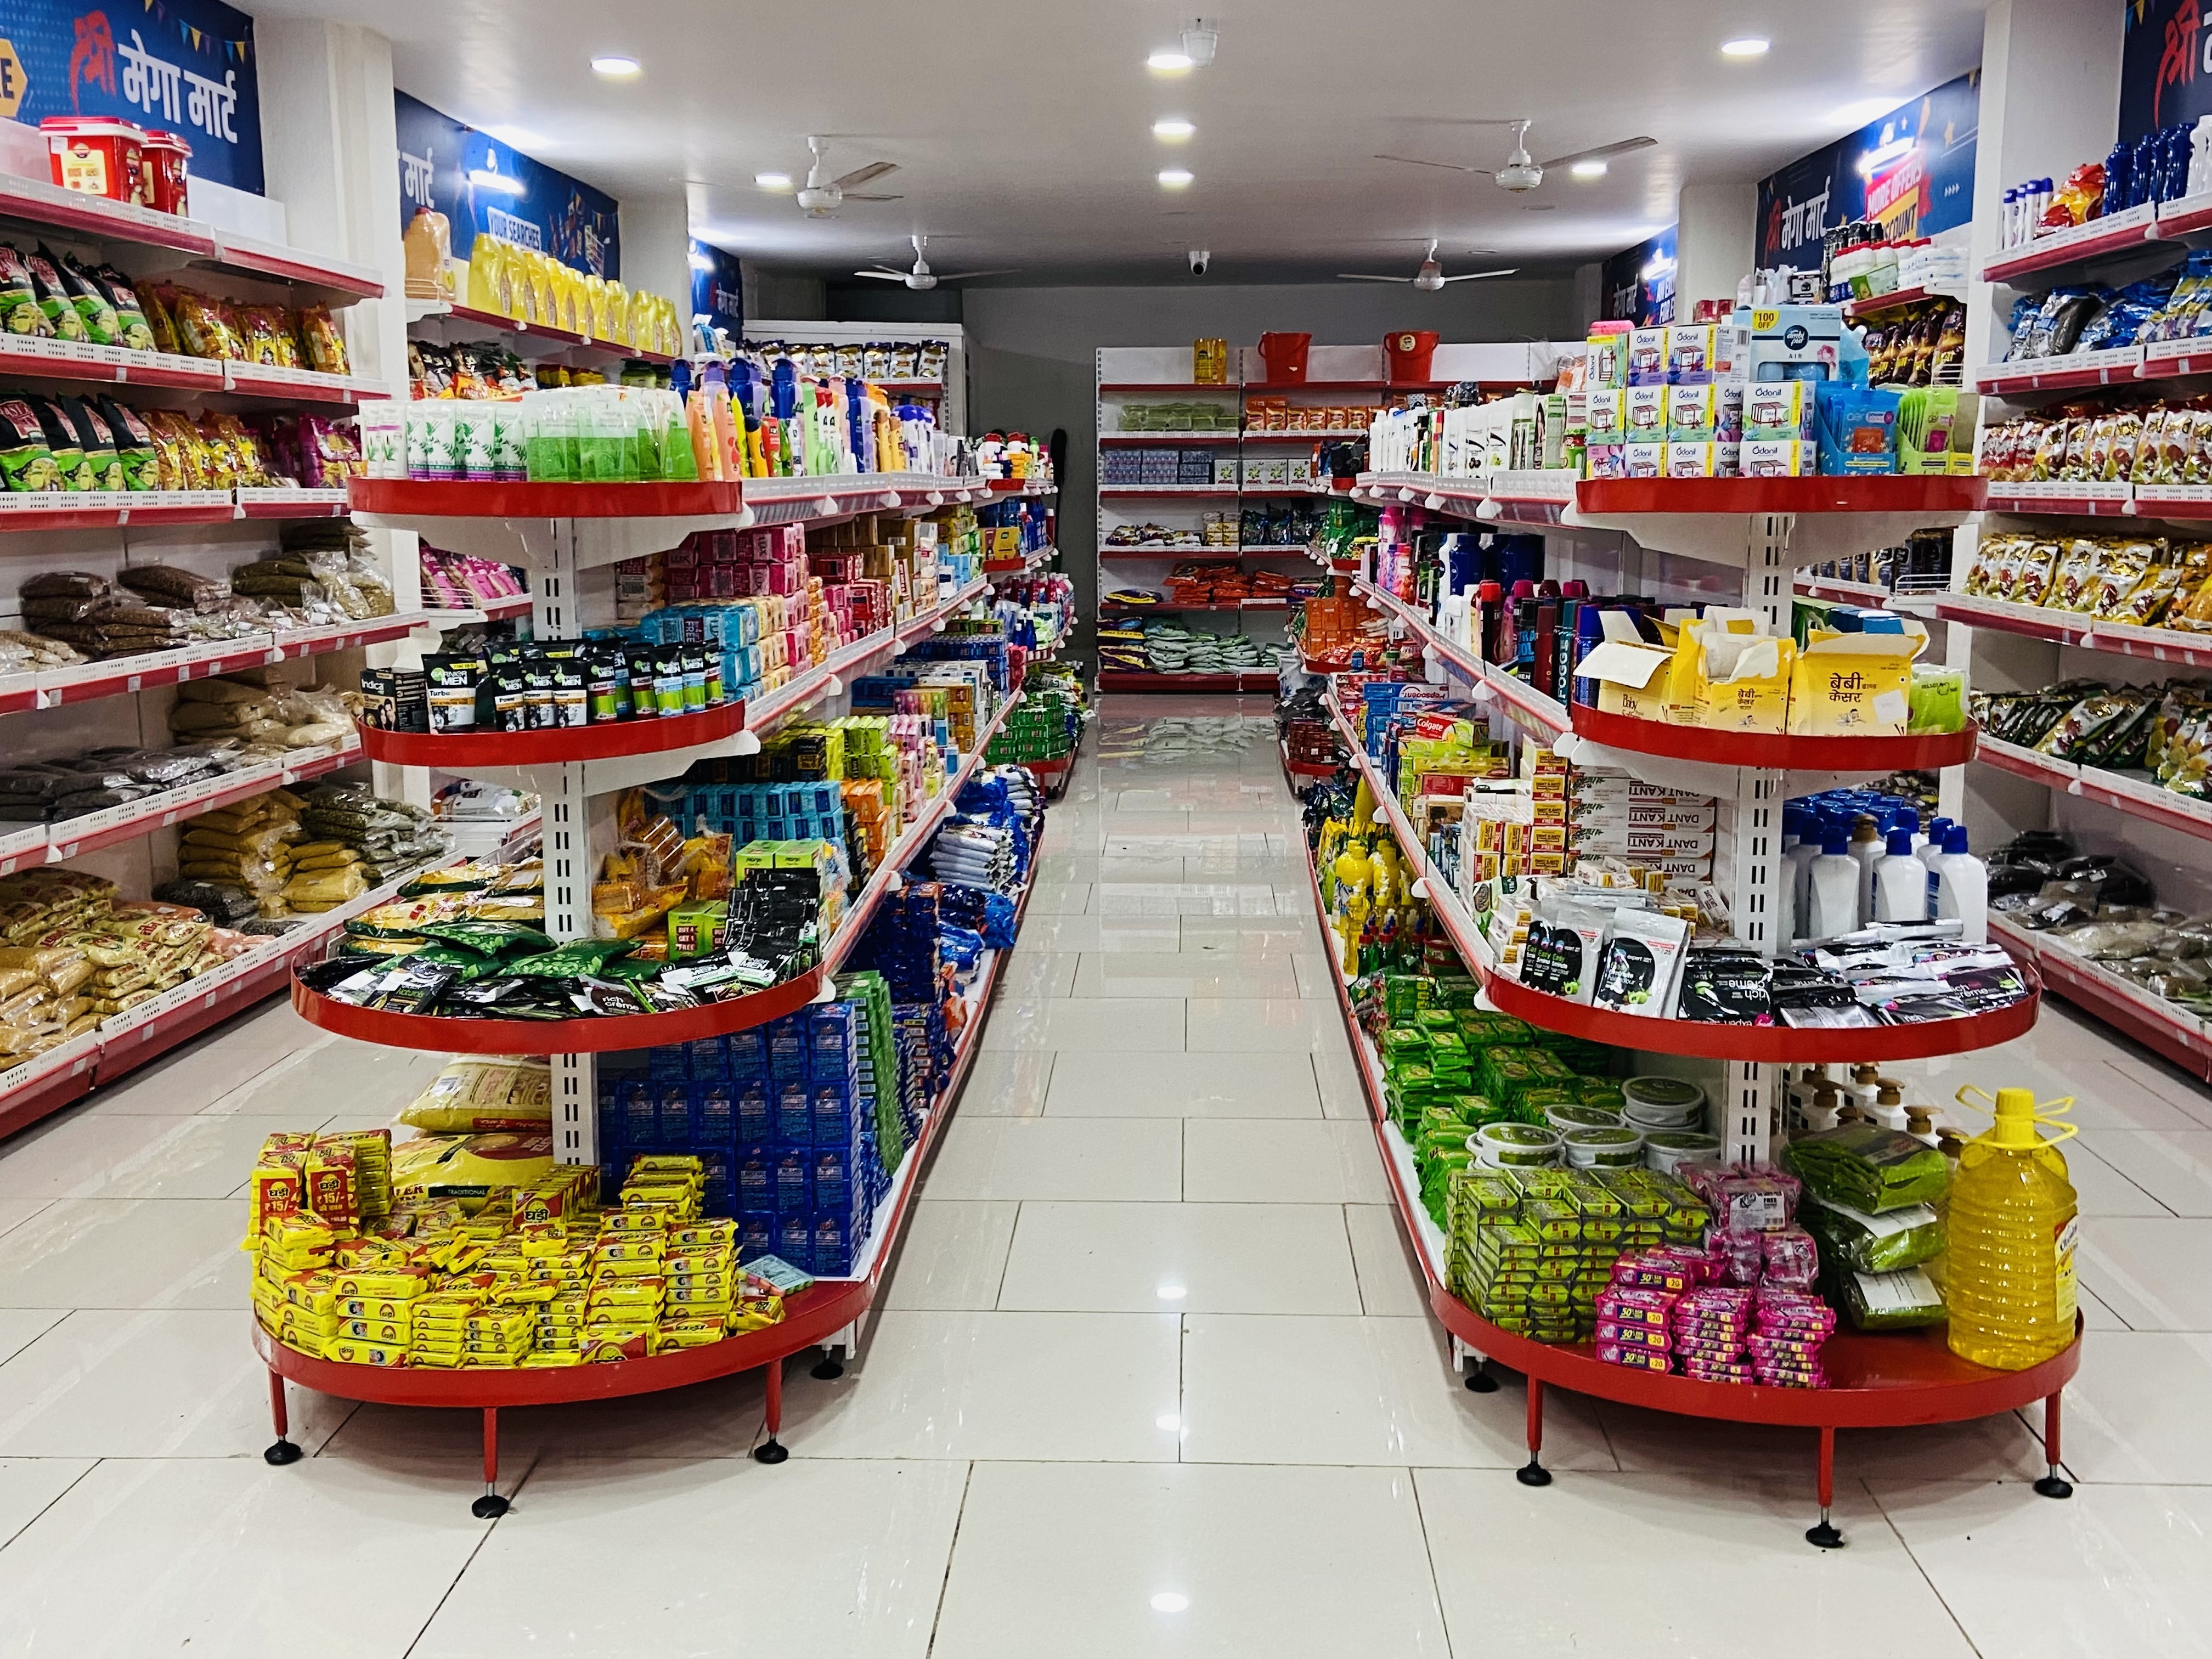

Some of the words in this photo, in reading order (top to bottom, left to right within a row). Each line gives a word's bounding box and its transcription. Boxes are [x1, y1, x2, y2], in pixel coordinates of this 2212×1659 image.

[117, 29, 181, 124] मेगा
[185, 70, 238, 144] मार्ट
[404, 147, 435, 208] मार्ट
[1866, 178, 1891, 221] MORE
[1891, 158, 1922, 202] OFFERS
[1781, 195, 1805, 251] मेगा
[1805, 175, 1831, 241] मार्ट
[509, 220, 539, 251] SEARCHES
[1637, 334, 1656, 344] Odonil
[1677, 332, 1699, 341] Odonil
[1635, 391, 1654, 400] Odonil
[1678, 390, 1700, 399] Odonil
[1755, 386, 1782, 397] Odonil
[1593, 394, 1611, 404] Odonil
[1633, 448, 1652, 458] Odonil
[1676, 446, 1696, 456] Odonil
[1752, 445, 1778, 455] Odonil
[622, 565, 643, 574] FREE
[361, 678, 384, 690] Indica
[441, 676, 468, 686] MEN
[1830, 672, 1864, 690] बेबी
[1622, 693, 1638, 710] Baby
[1828, 690, 1863, 703] केसर
[1417, 718, 1444, 732] Colgate
[1628, 812, 1666, 821] KANTI
[1667, 814, 1700, 823] DANT
[1627, 838, 1664, 848] KANTI
[1666, 840, 1699, 849] DANT
[1664, 864, 1696, 873] DANT
[804, 926, 810, 934] 5
[741, 960, 769, 970] MEN
[1744, 989, 1766, 1001] rich
[523, 1209, 549, 1223] घड़ी
